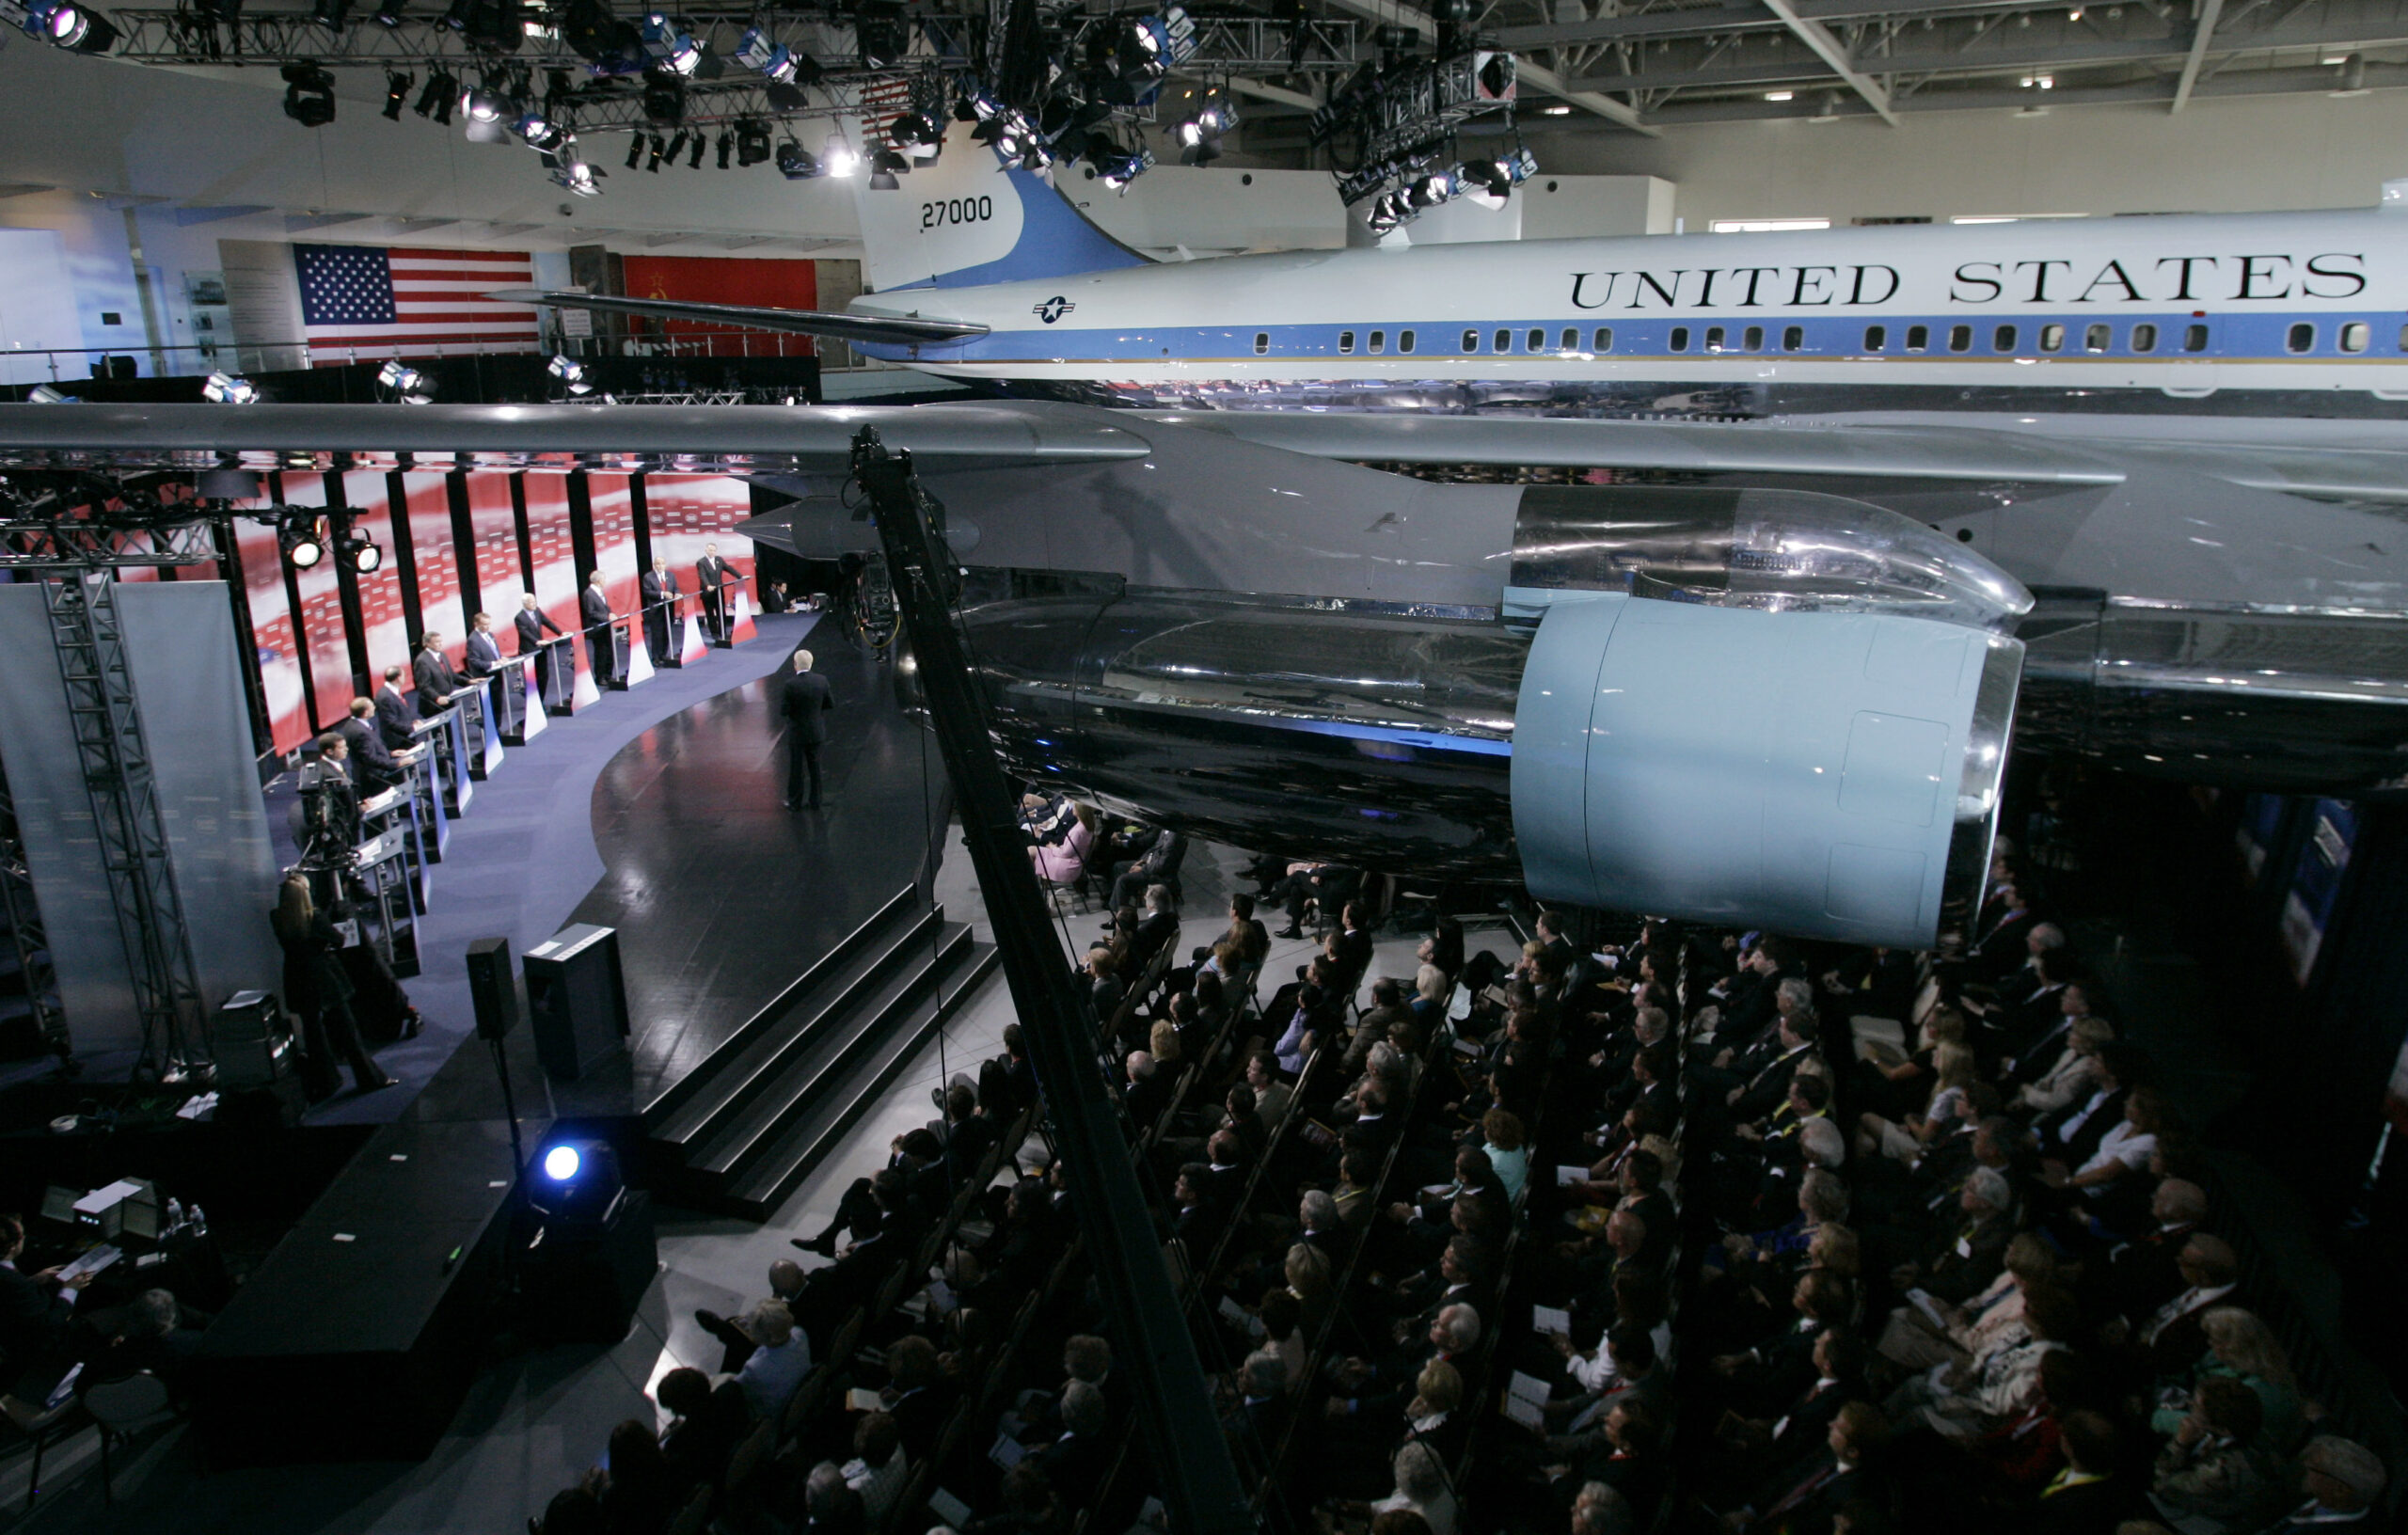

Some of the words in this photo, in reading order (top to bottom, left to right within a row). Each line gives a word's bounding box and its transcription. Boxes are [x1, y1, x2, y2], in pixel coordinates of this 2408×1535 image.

[922, 195, 992, 228] 27000
[1570, 264, 1900, 309] UNITED
[1949, 253, 2367, 303] STATES
